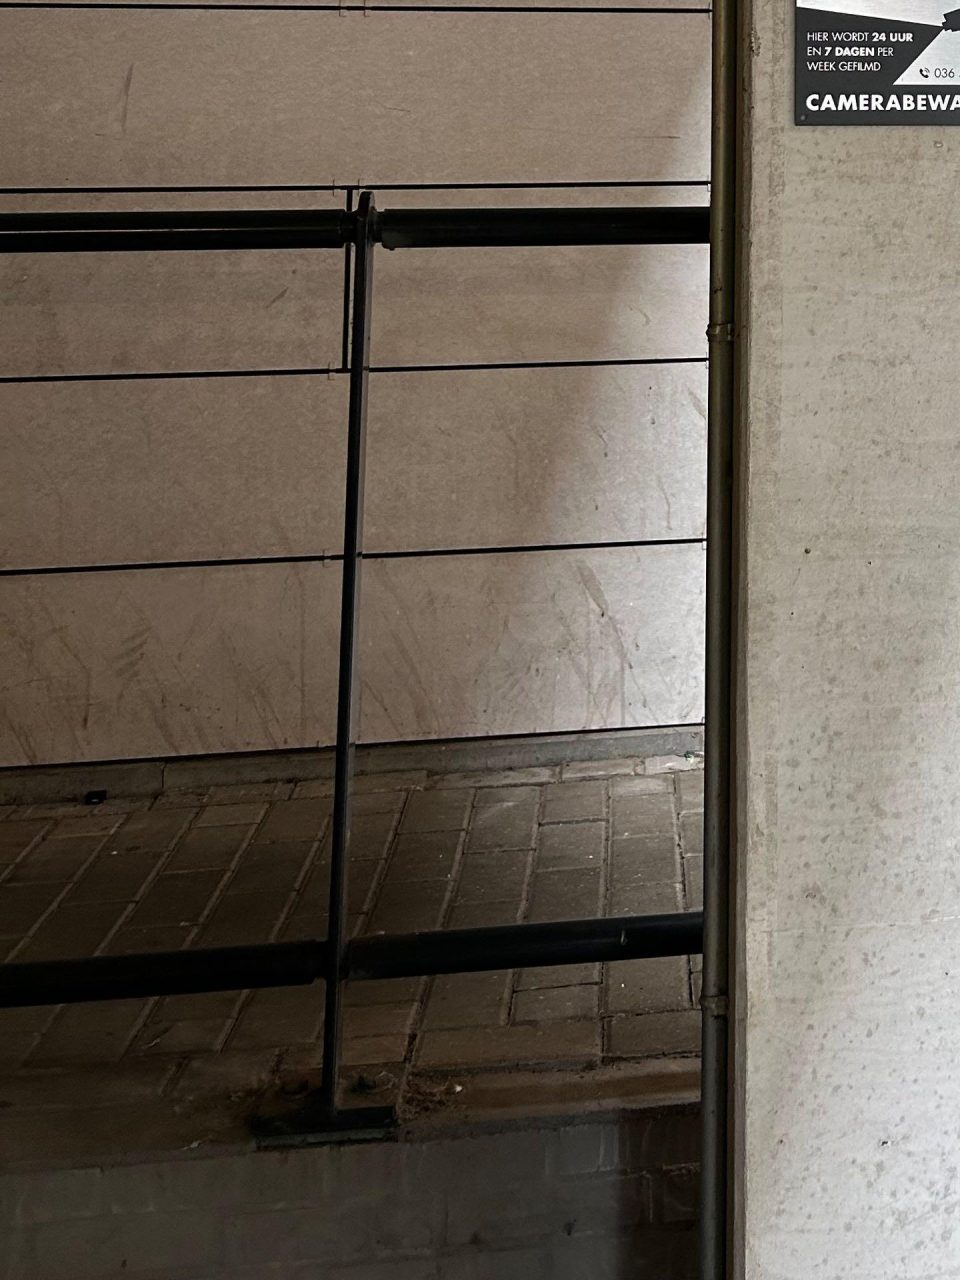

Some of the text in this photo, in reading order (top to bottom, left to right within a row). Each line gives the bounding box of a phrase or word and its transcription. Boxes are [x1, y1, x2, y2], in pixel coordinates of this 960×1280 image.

[807, 32, 914, 42] HIER WORDT 24 UUR
[807, 47, 894, 57] EN 7 DAGEN PER
[806, 61, 882, 72] WEEK GEFILMD
[934, 67, 955, 79] 036
